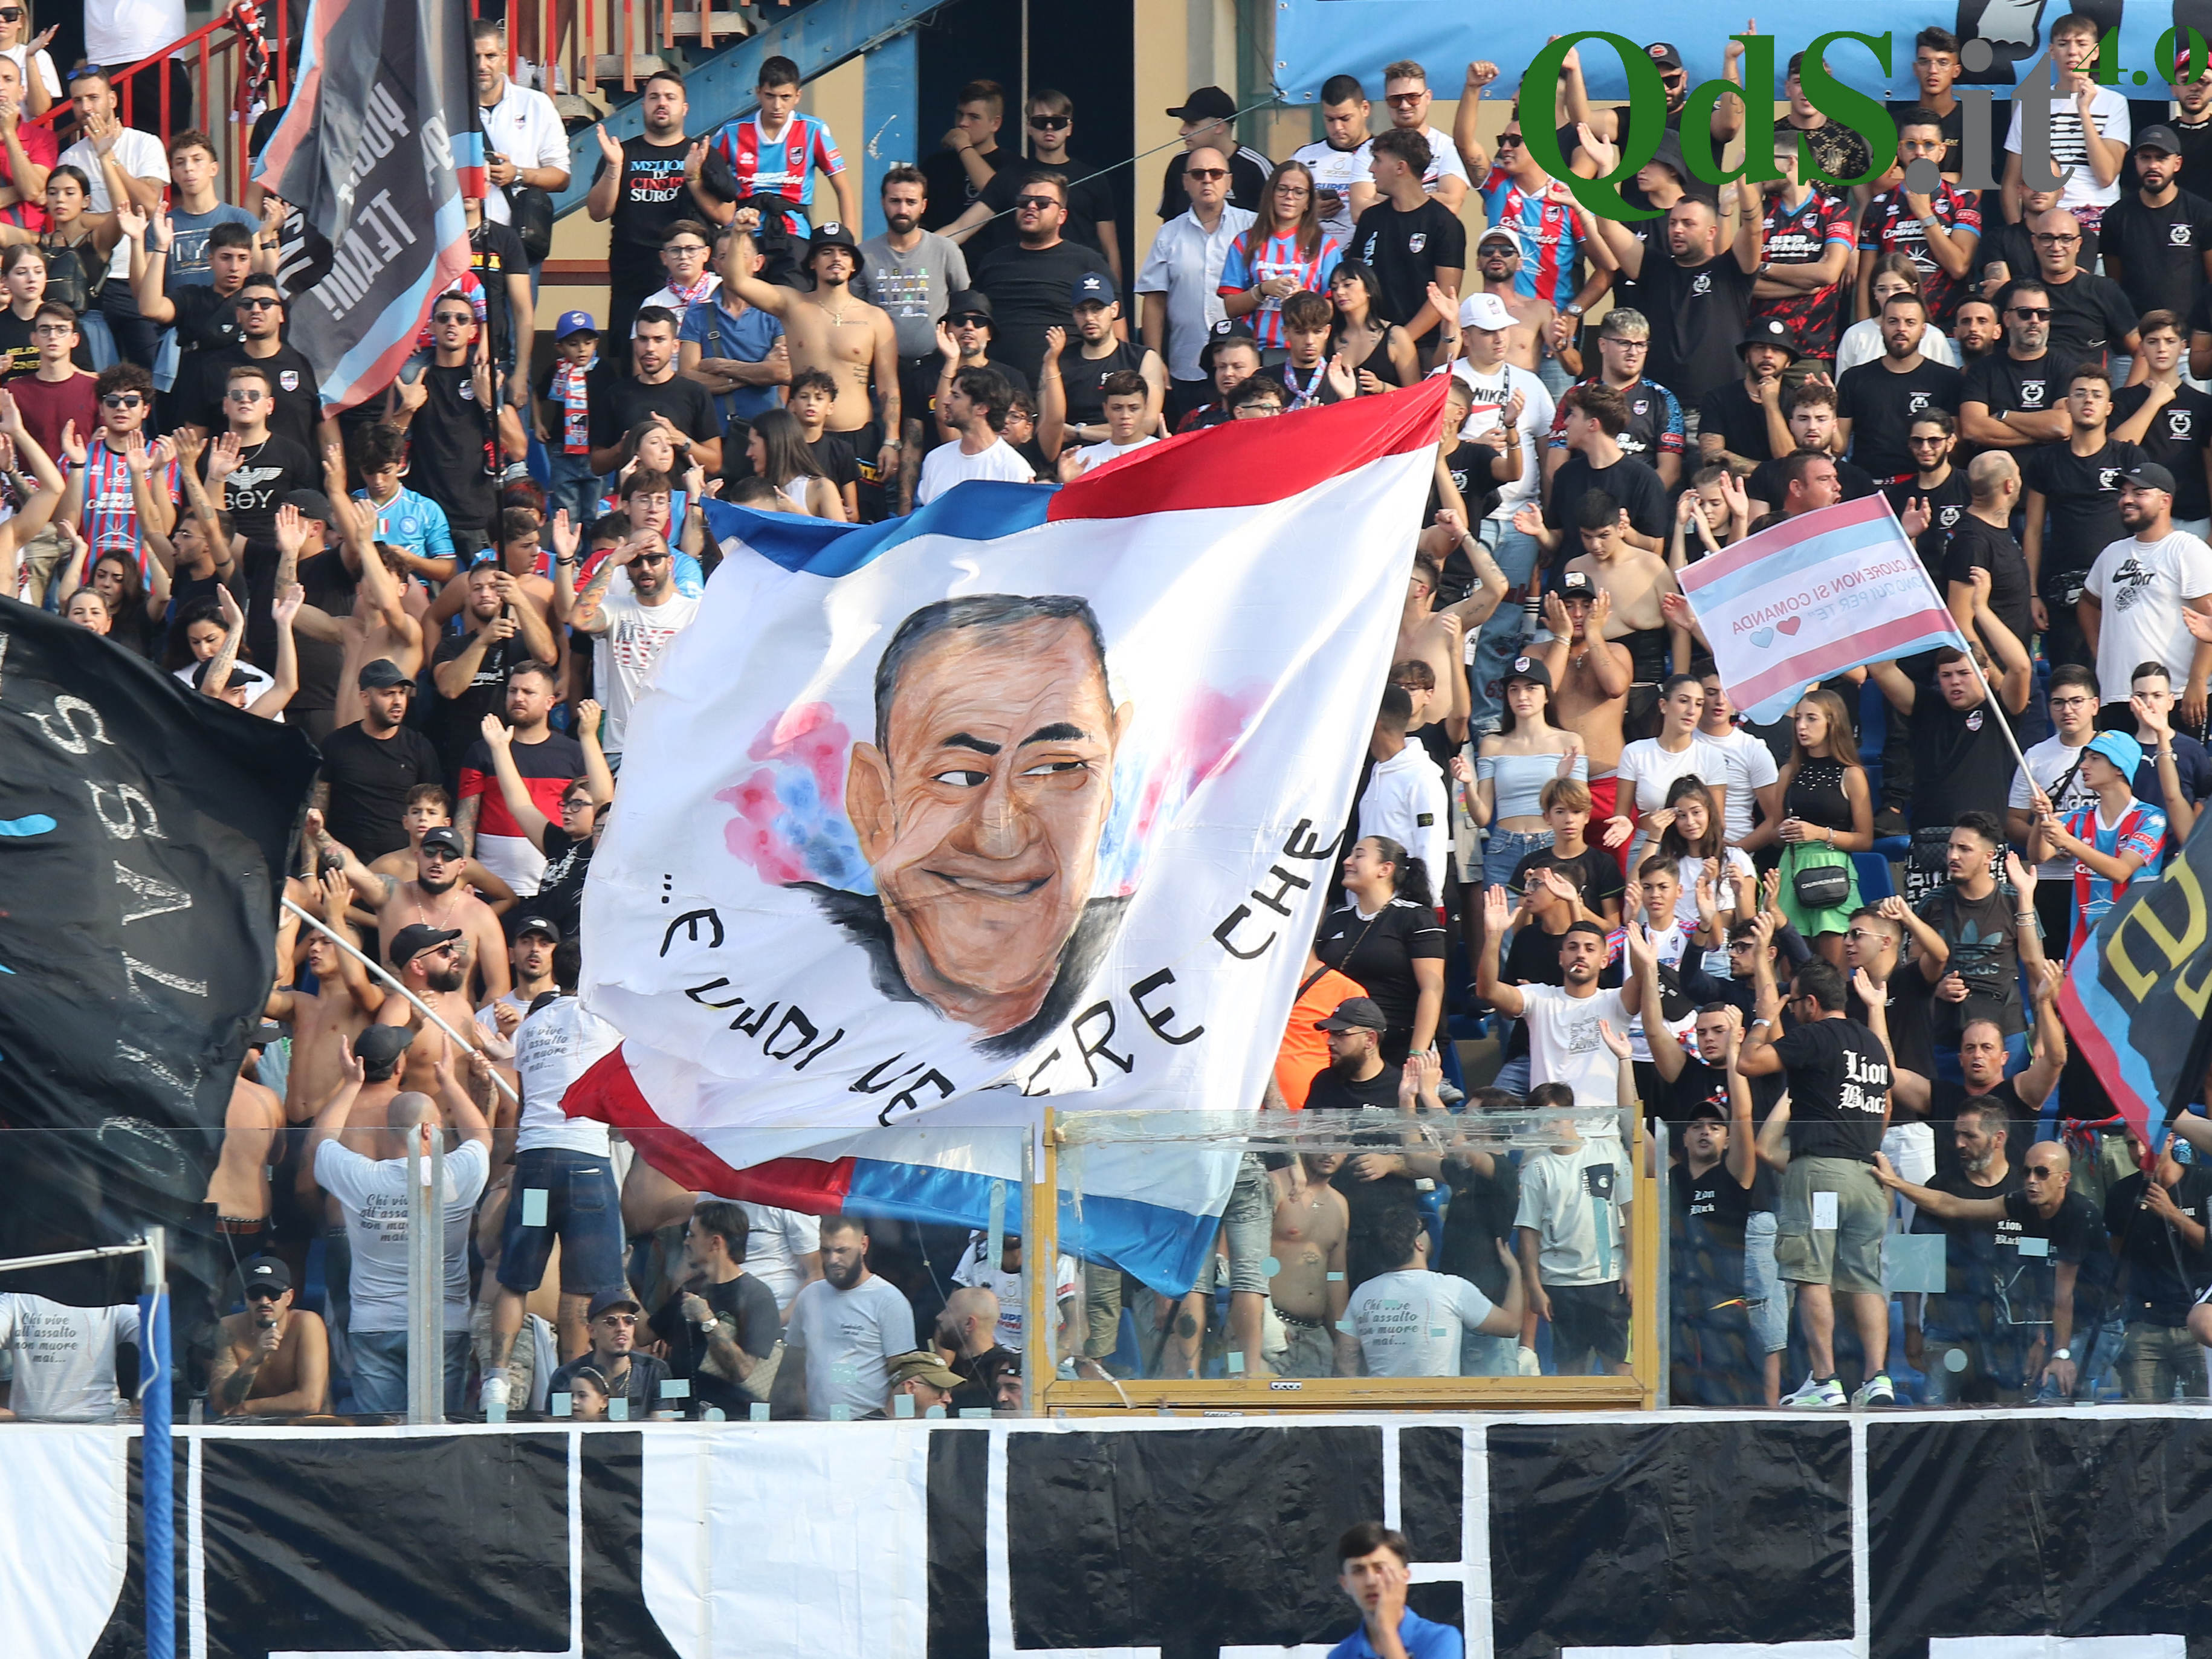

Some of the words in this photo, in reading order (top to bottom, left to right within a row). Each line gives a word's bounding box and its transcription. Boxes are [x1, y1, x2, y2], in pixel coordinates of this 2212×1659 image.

[1212, 818, 1346, 960] CHE
[0, 632, 209, 1177] SSALTO
[537, 1026, 563, 1035] vive
[533, 1047, 568, 1059] muore
[1842, 1049, 1888, 1085] Lion
[366, 1194, 387, 1206] Chi
[1997, 1219, 2023, 1232] Lion
[1363, 1299, 1382, 1311] Chi
[21, 1312, 40, 1325] Chi
[45, 1313, 70, 1325] vive
[1377, 1325, 1419, 1334] muore
[15, 1340, 34, 1350] non
[39, 1340, 78, 1351] muore
